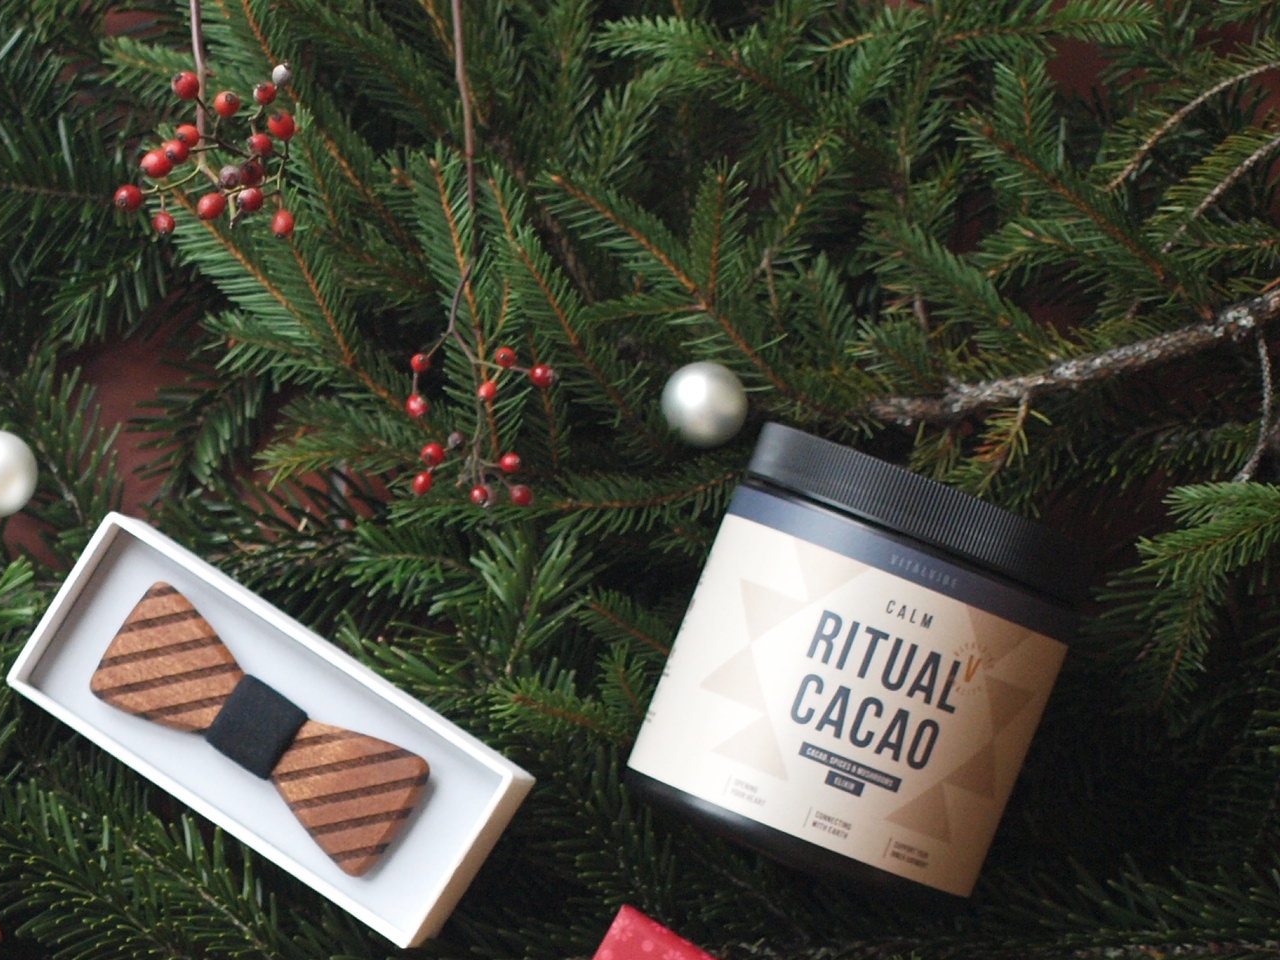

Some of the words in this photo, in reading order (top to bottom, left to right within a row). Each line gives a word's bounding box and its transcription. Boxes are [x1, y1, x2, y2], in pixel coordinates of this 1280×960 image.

[806, 609, 961, 714] RITUAL
[886, 600, 934, 629] CALM
[790, 674, 940, 770] CACAO
